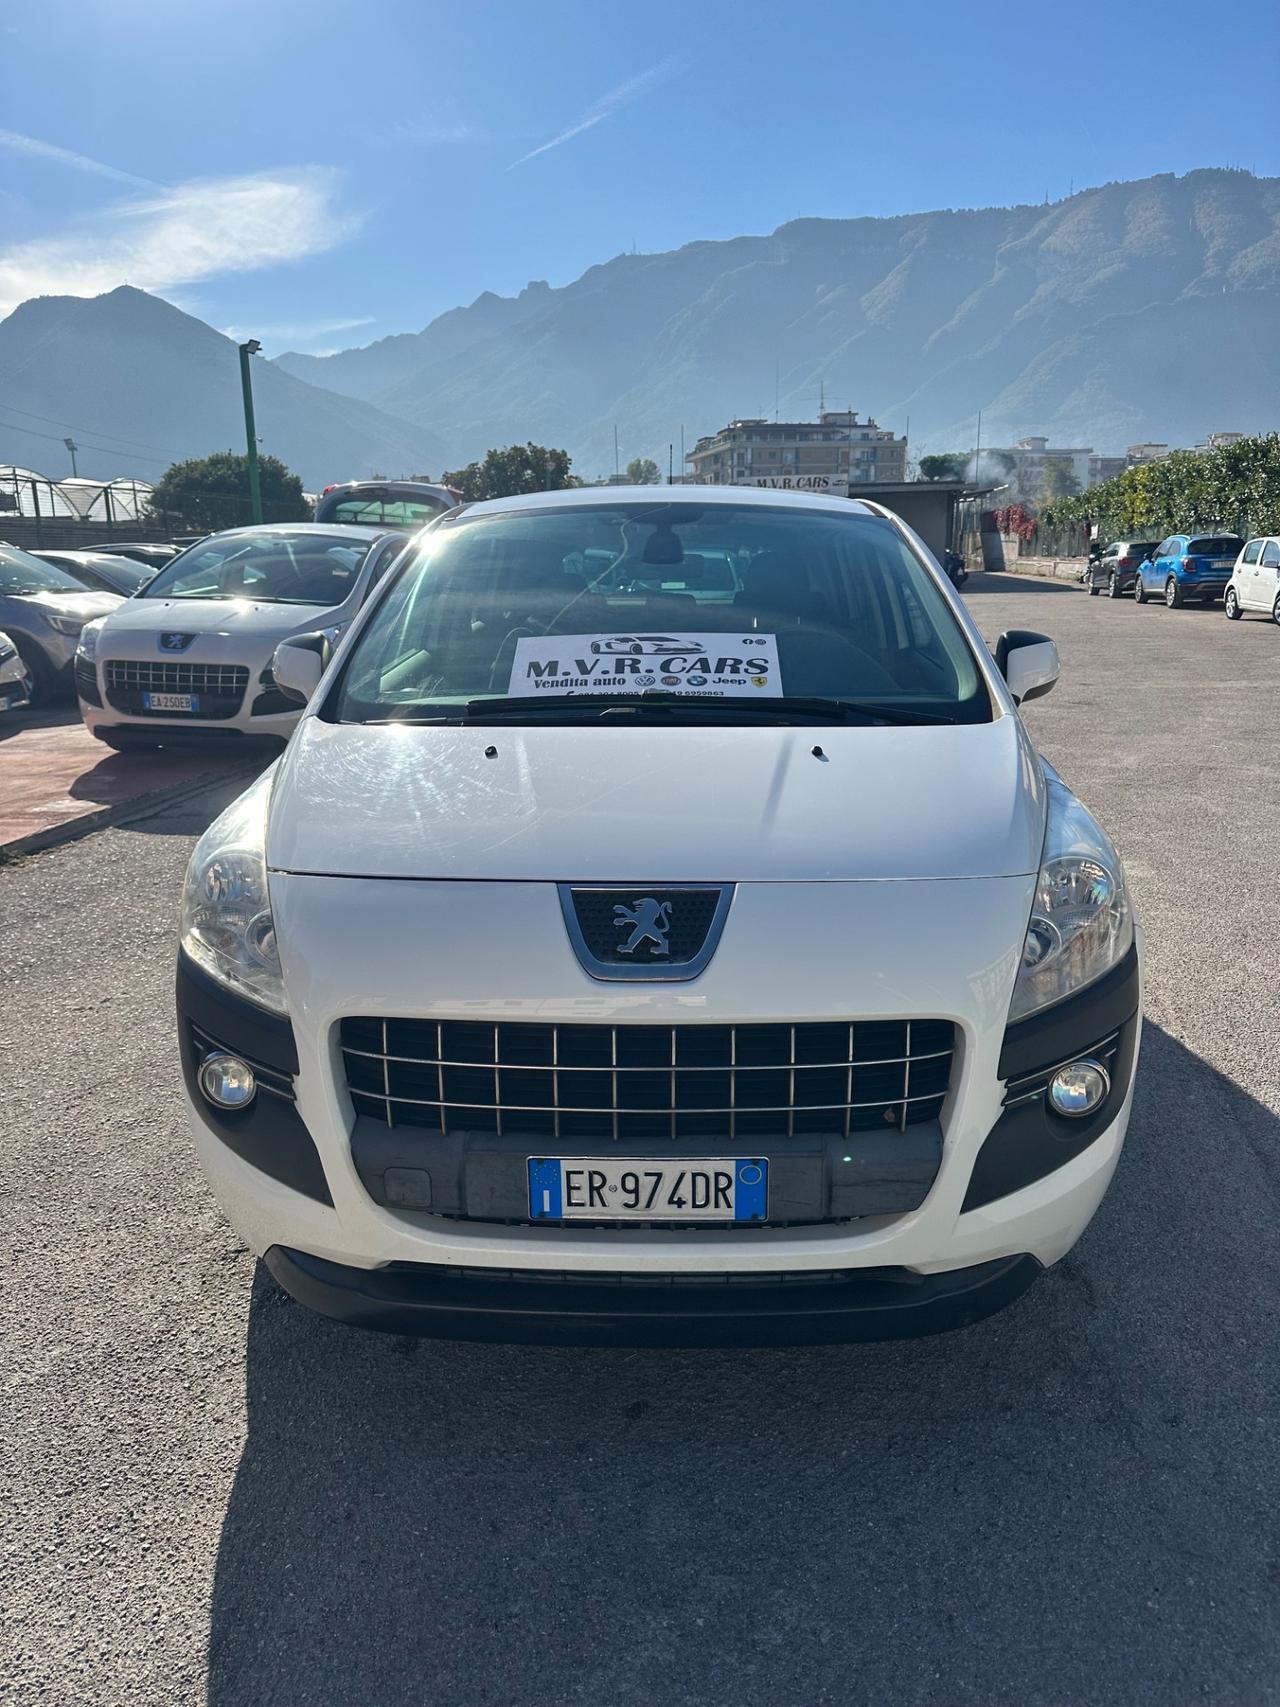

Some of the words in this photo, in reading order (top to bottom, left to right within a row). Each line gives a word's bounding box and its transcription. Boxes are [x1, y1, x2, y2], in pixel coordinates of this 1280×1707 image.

[534, 678, 588, 689] Vendita
[592, 676, 626, 686] auto
[712, 677, 747, 685] Jeep
